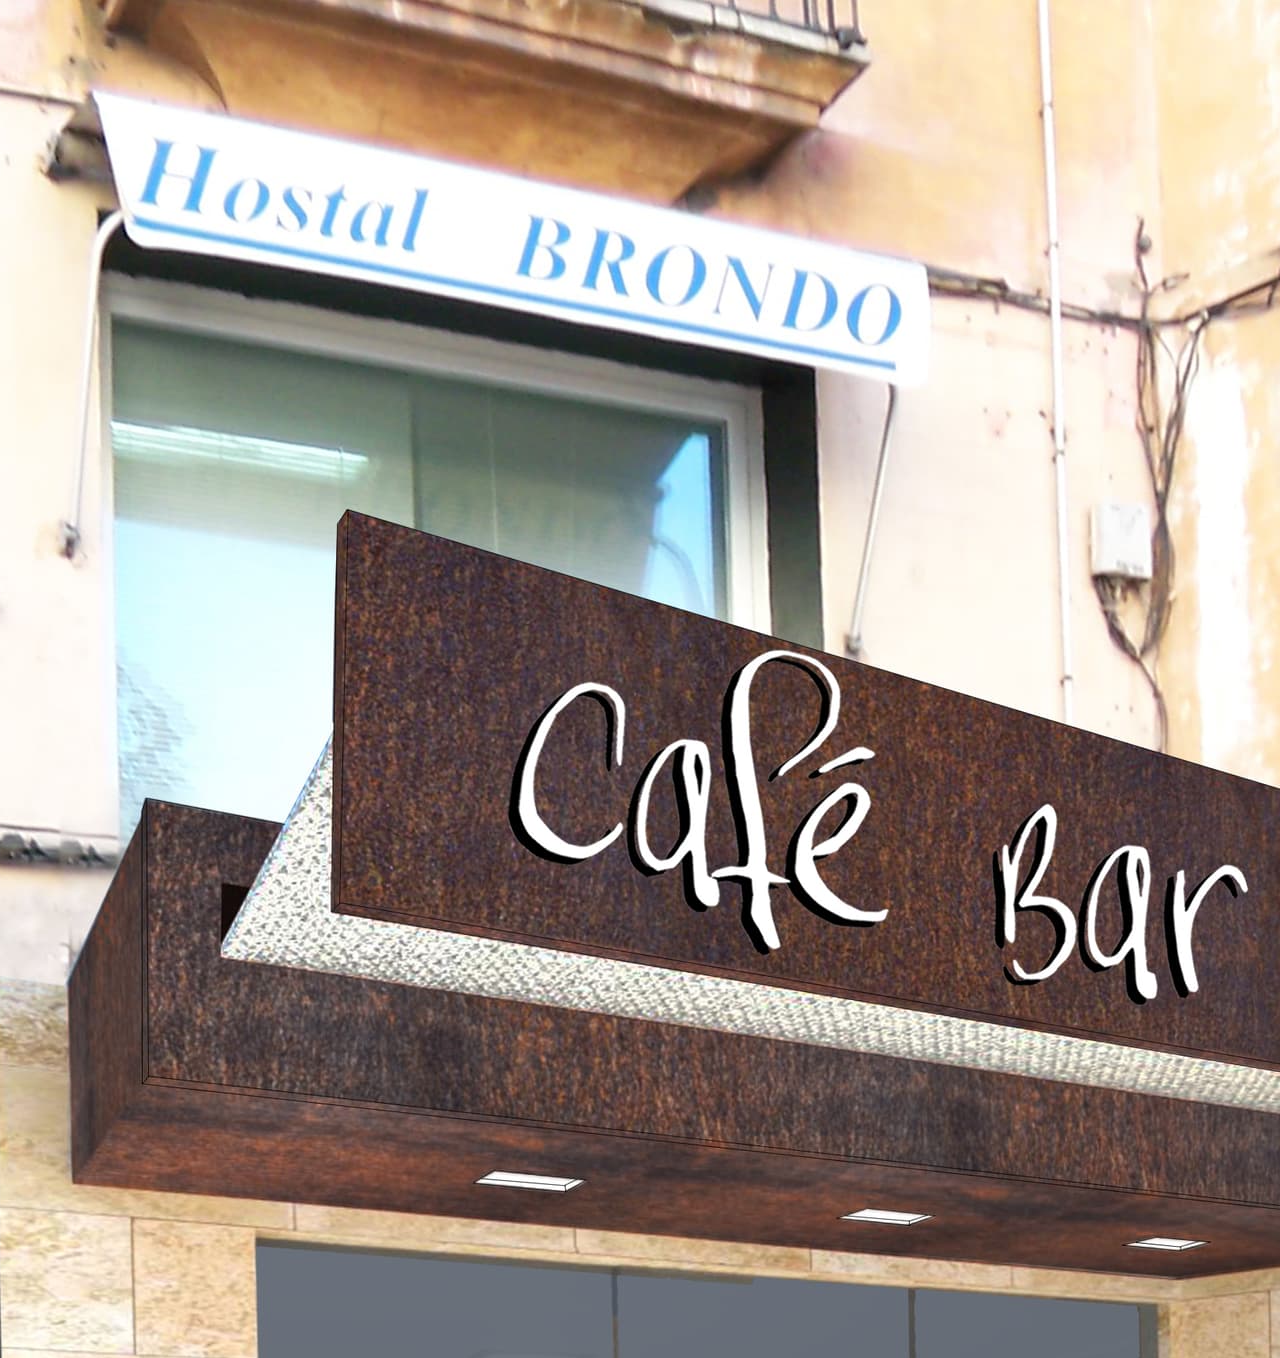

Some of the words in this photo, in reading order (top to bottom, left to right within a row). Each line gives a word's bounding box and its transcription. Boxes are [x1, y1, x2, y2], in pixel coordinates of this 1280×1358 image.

[139, 137, 429, 253] Hostal
[516, 214, 903, 347] BRONDO
[510, 650, 888, 953] Café
[996, 804, 1248, 1001] Bar
